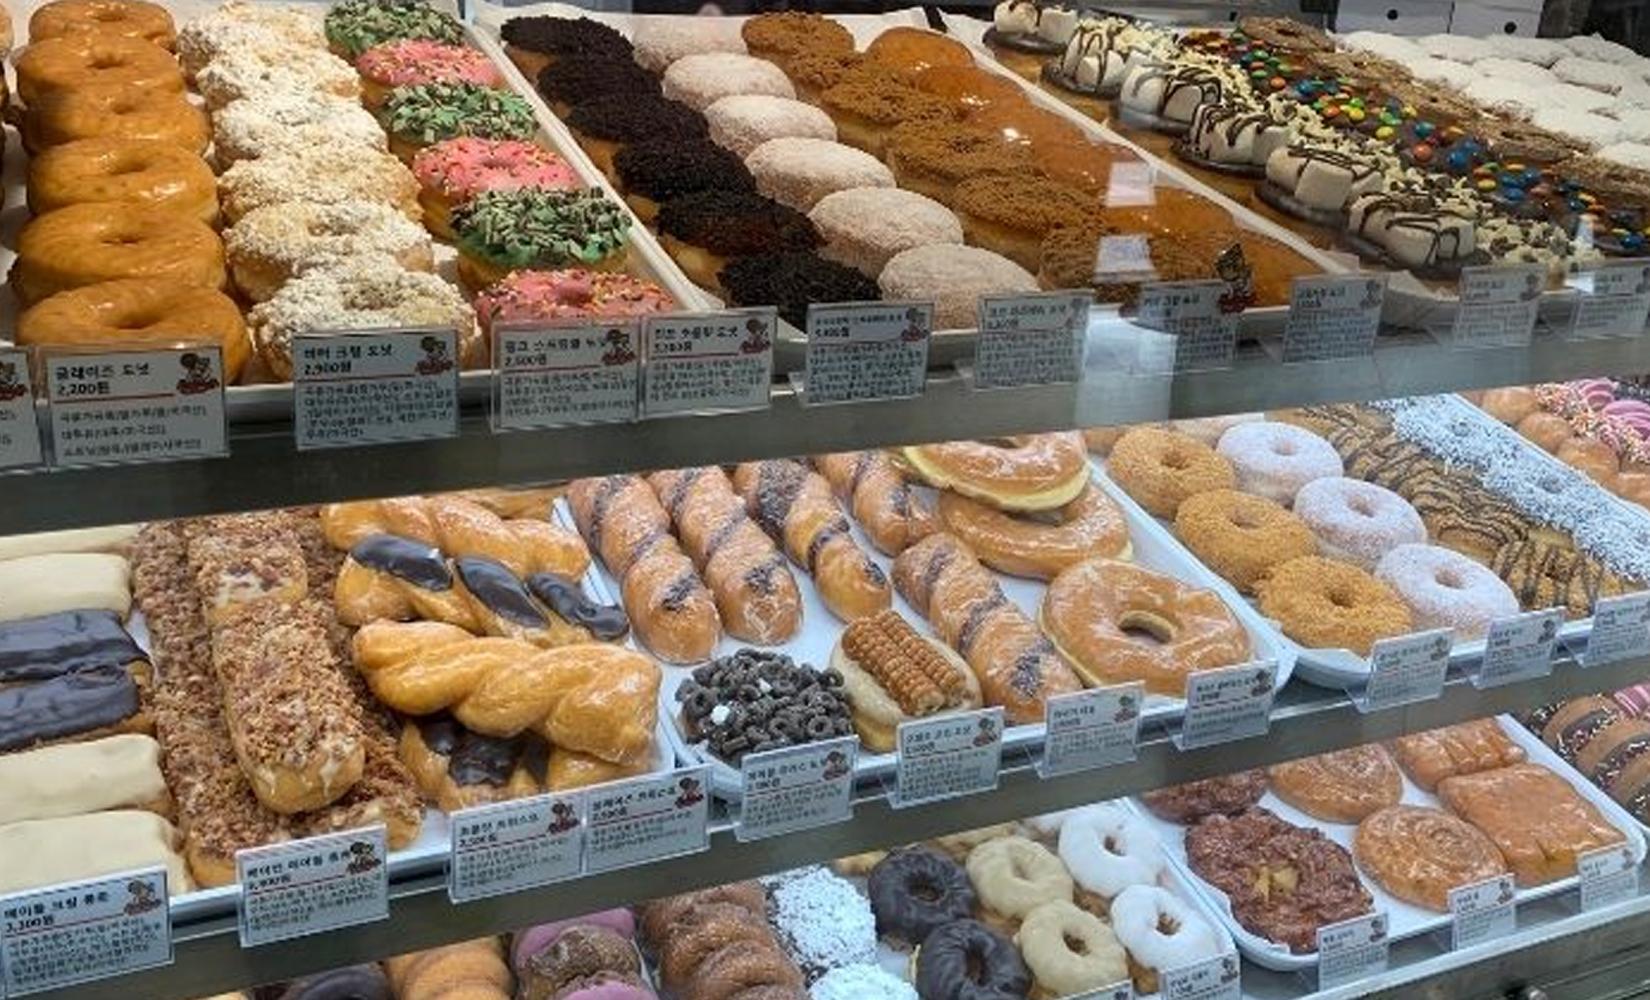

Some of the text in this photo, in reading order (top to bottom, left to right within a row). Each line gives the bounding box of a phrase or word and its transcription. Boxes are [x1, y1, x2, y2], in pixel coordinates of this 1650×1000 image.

[367, 343, 394, 357] 도넛
[56, 362, 150, 380] 글레이즈 도넛
[57, 381, 112, 397] 2,200원
